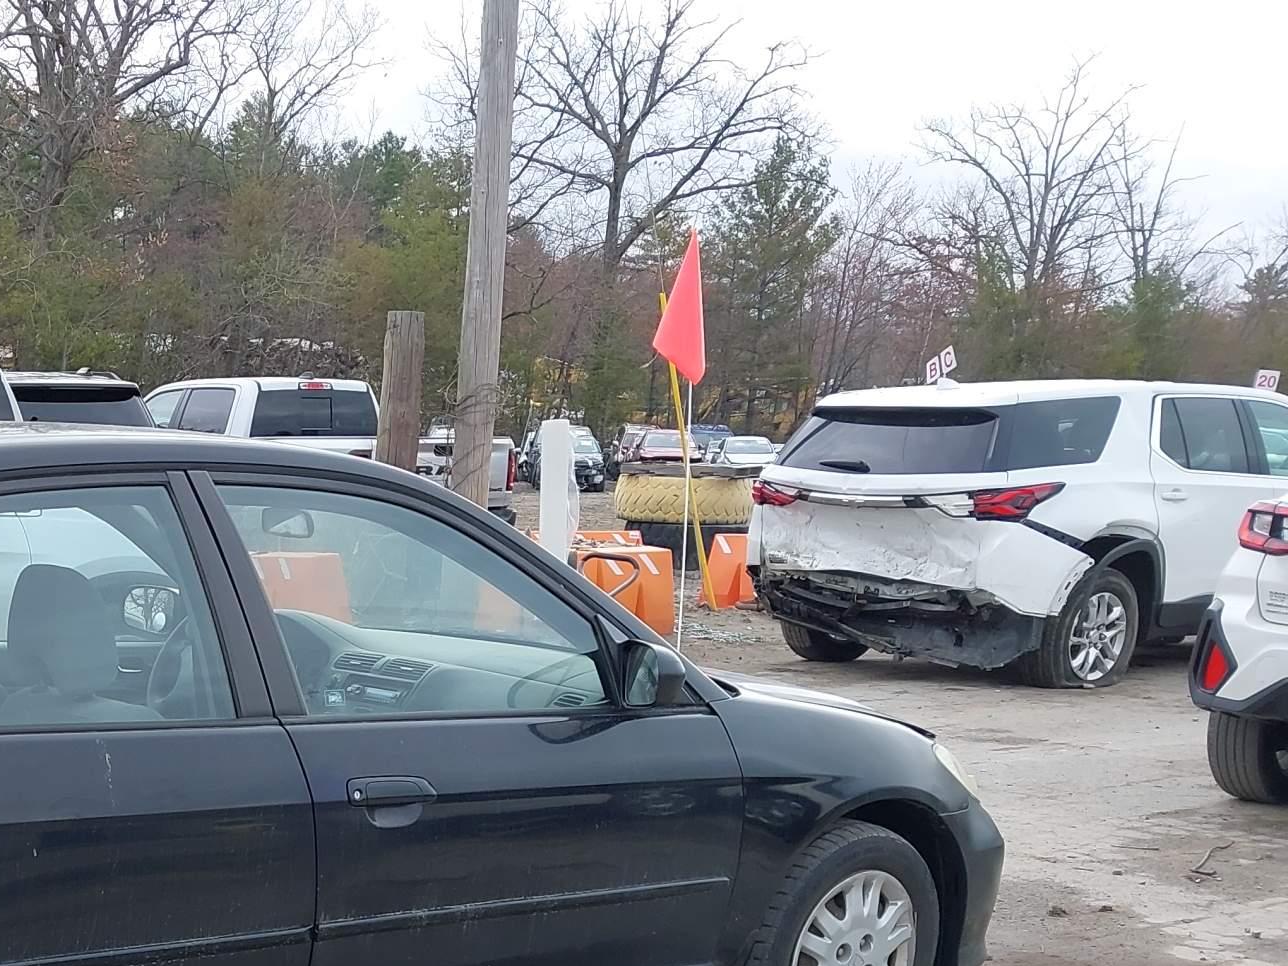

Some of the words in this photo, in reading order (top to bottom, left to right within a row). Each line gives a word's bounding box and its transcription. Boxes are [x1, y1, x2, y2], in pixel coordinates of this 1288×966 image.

[929, 362, 938, 380] B
[943, 351, 953, 368] C
[1257, 374, 1277, 389] 20
[415, 465, 452, 476] RA
